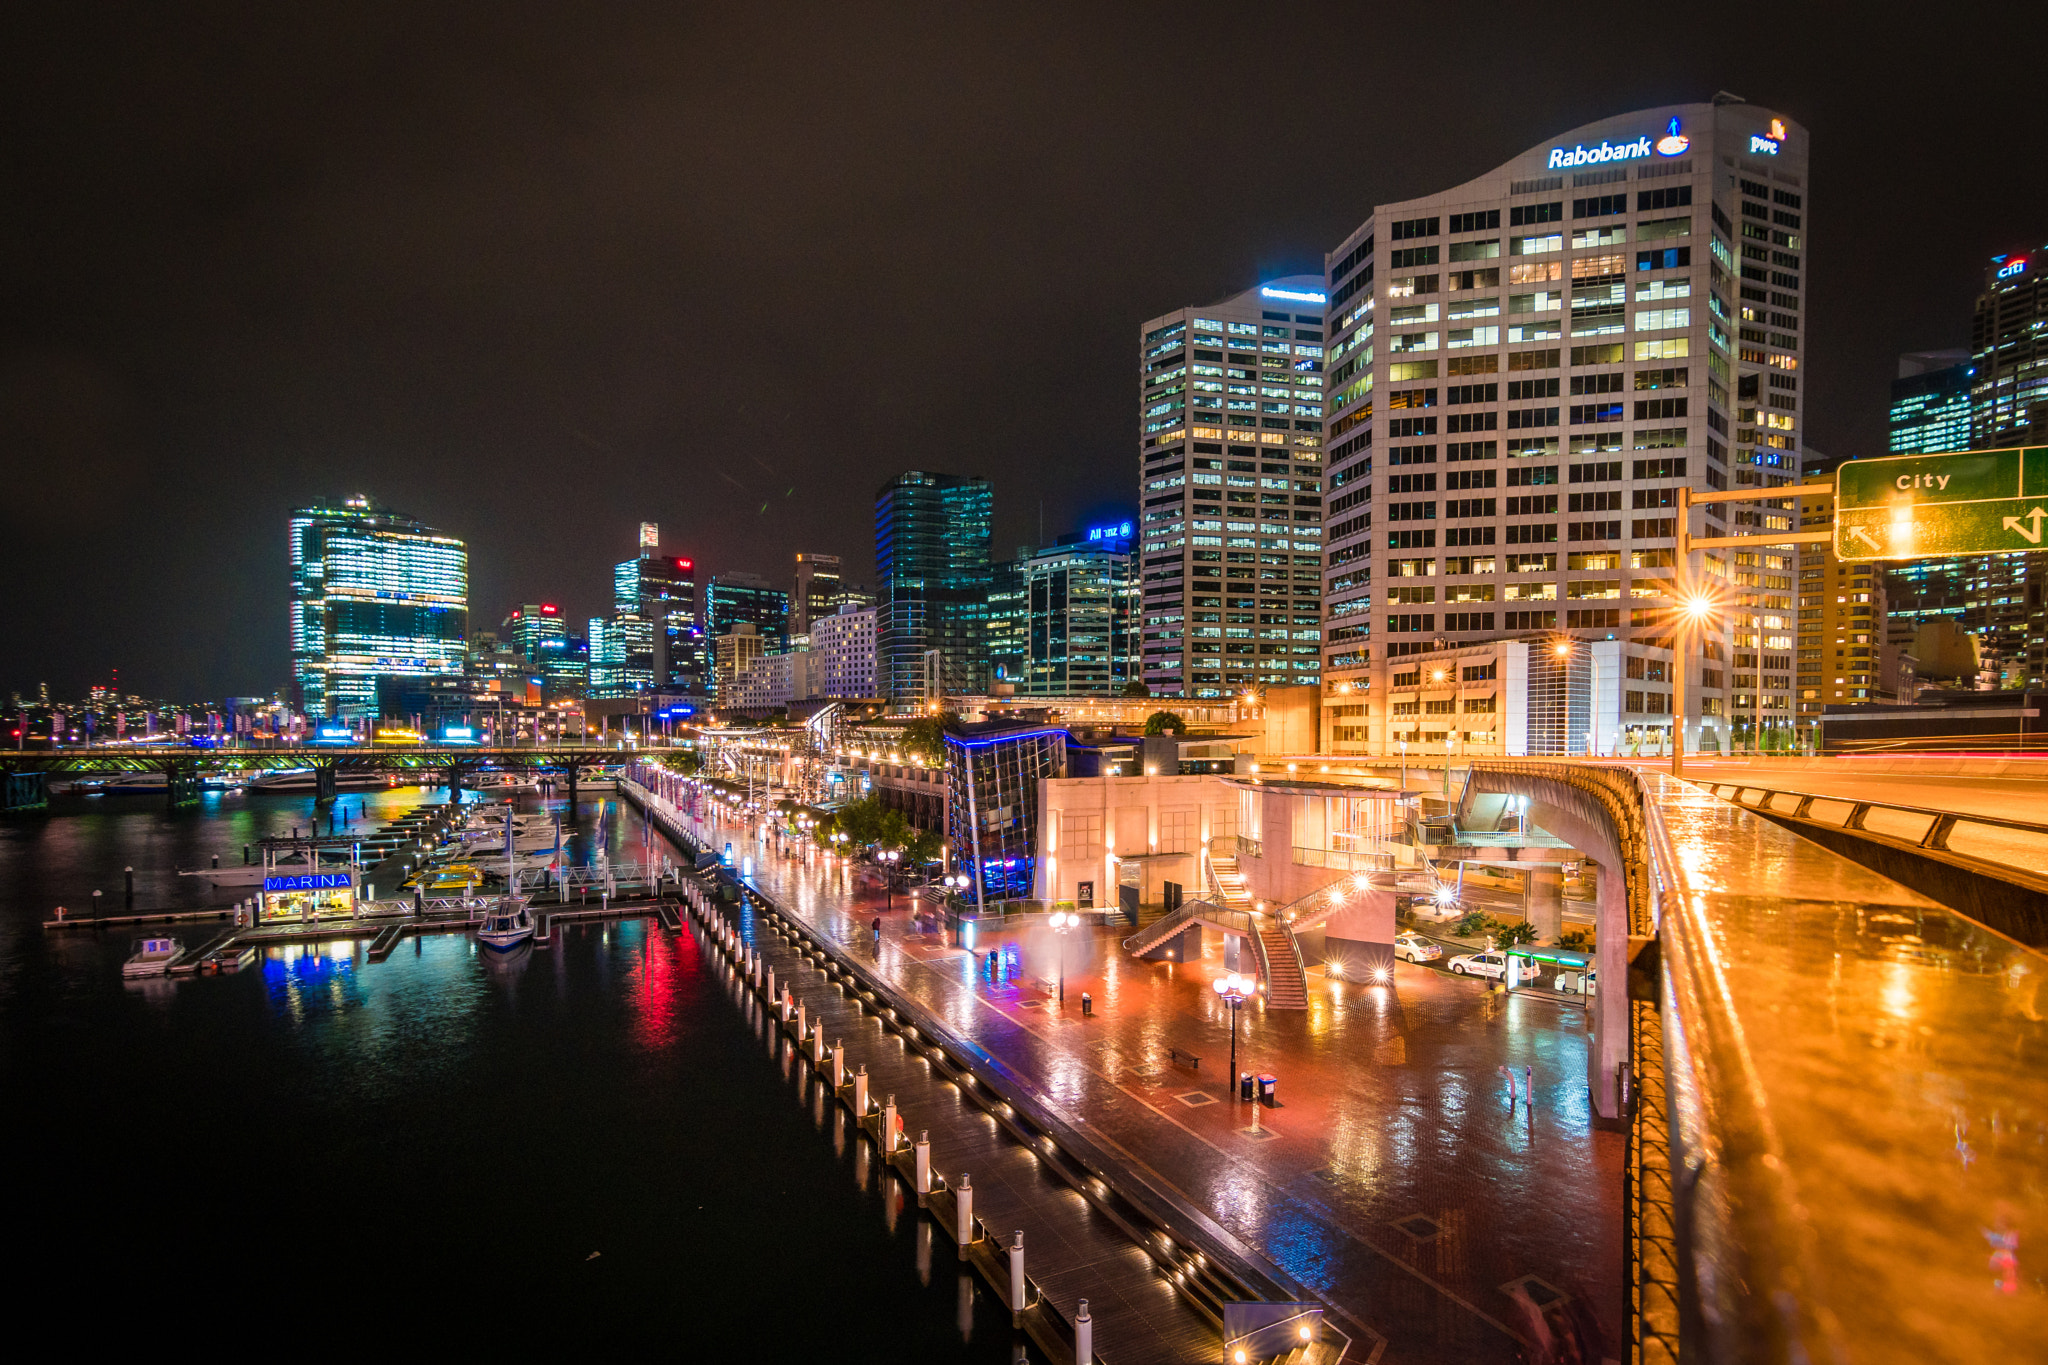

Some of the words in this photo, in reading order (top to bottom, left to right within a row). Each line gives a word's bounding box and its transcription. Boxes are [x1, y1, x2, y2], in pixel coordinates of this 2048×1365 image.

[1548, 135, 1652, 169] Rabobank
[1750, 135, 1778, 155] pwc
[1997, 262, 2025, 278] citi
[1896, 473, 1951, 490] City
[265, 873, 351, 891] MARINA
